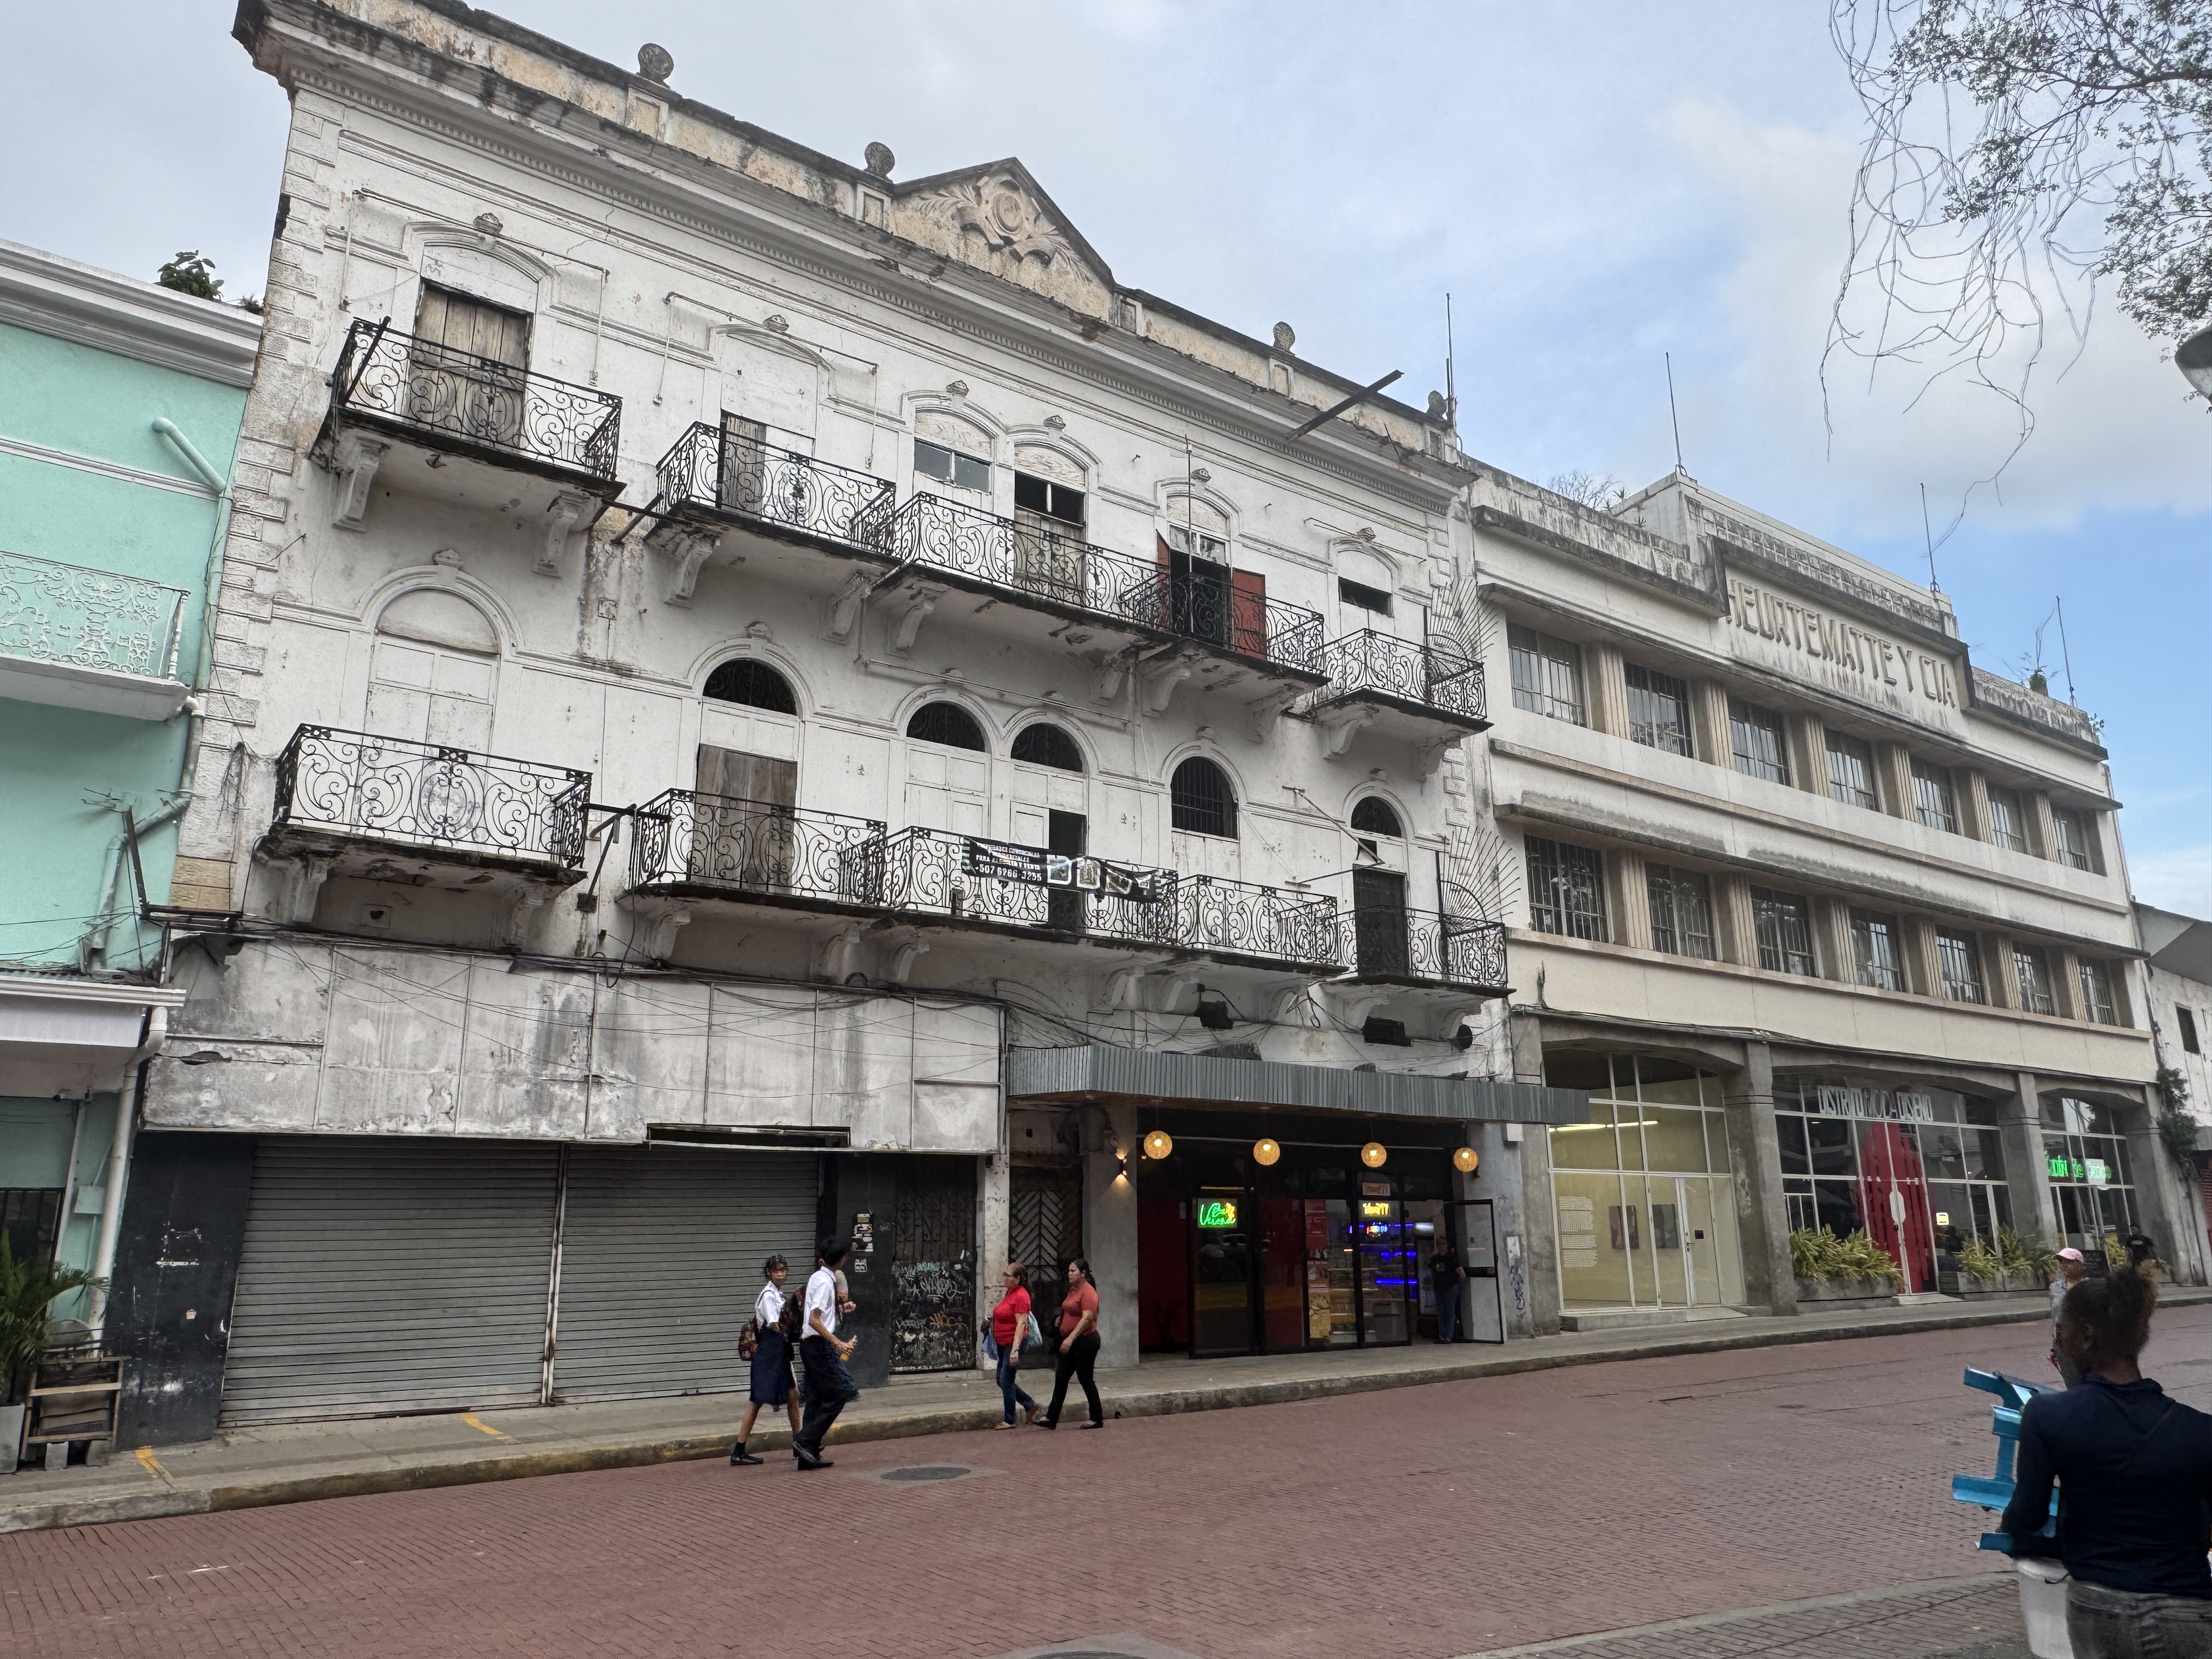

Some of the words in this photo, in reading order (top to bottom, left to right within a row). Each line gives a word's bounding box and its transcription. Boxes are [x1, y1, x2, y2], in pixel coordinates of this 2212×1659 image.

[1726, 578, 1898, 687] HEURTEMATTE
[1897, 645, 1914, 692] Y
[1919, 655, 1956, 709] CIA
